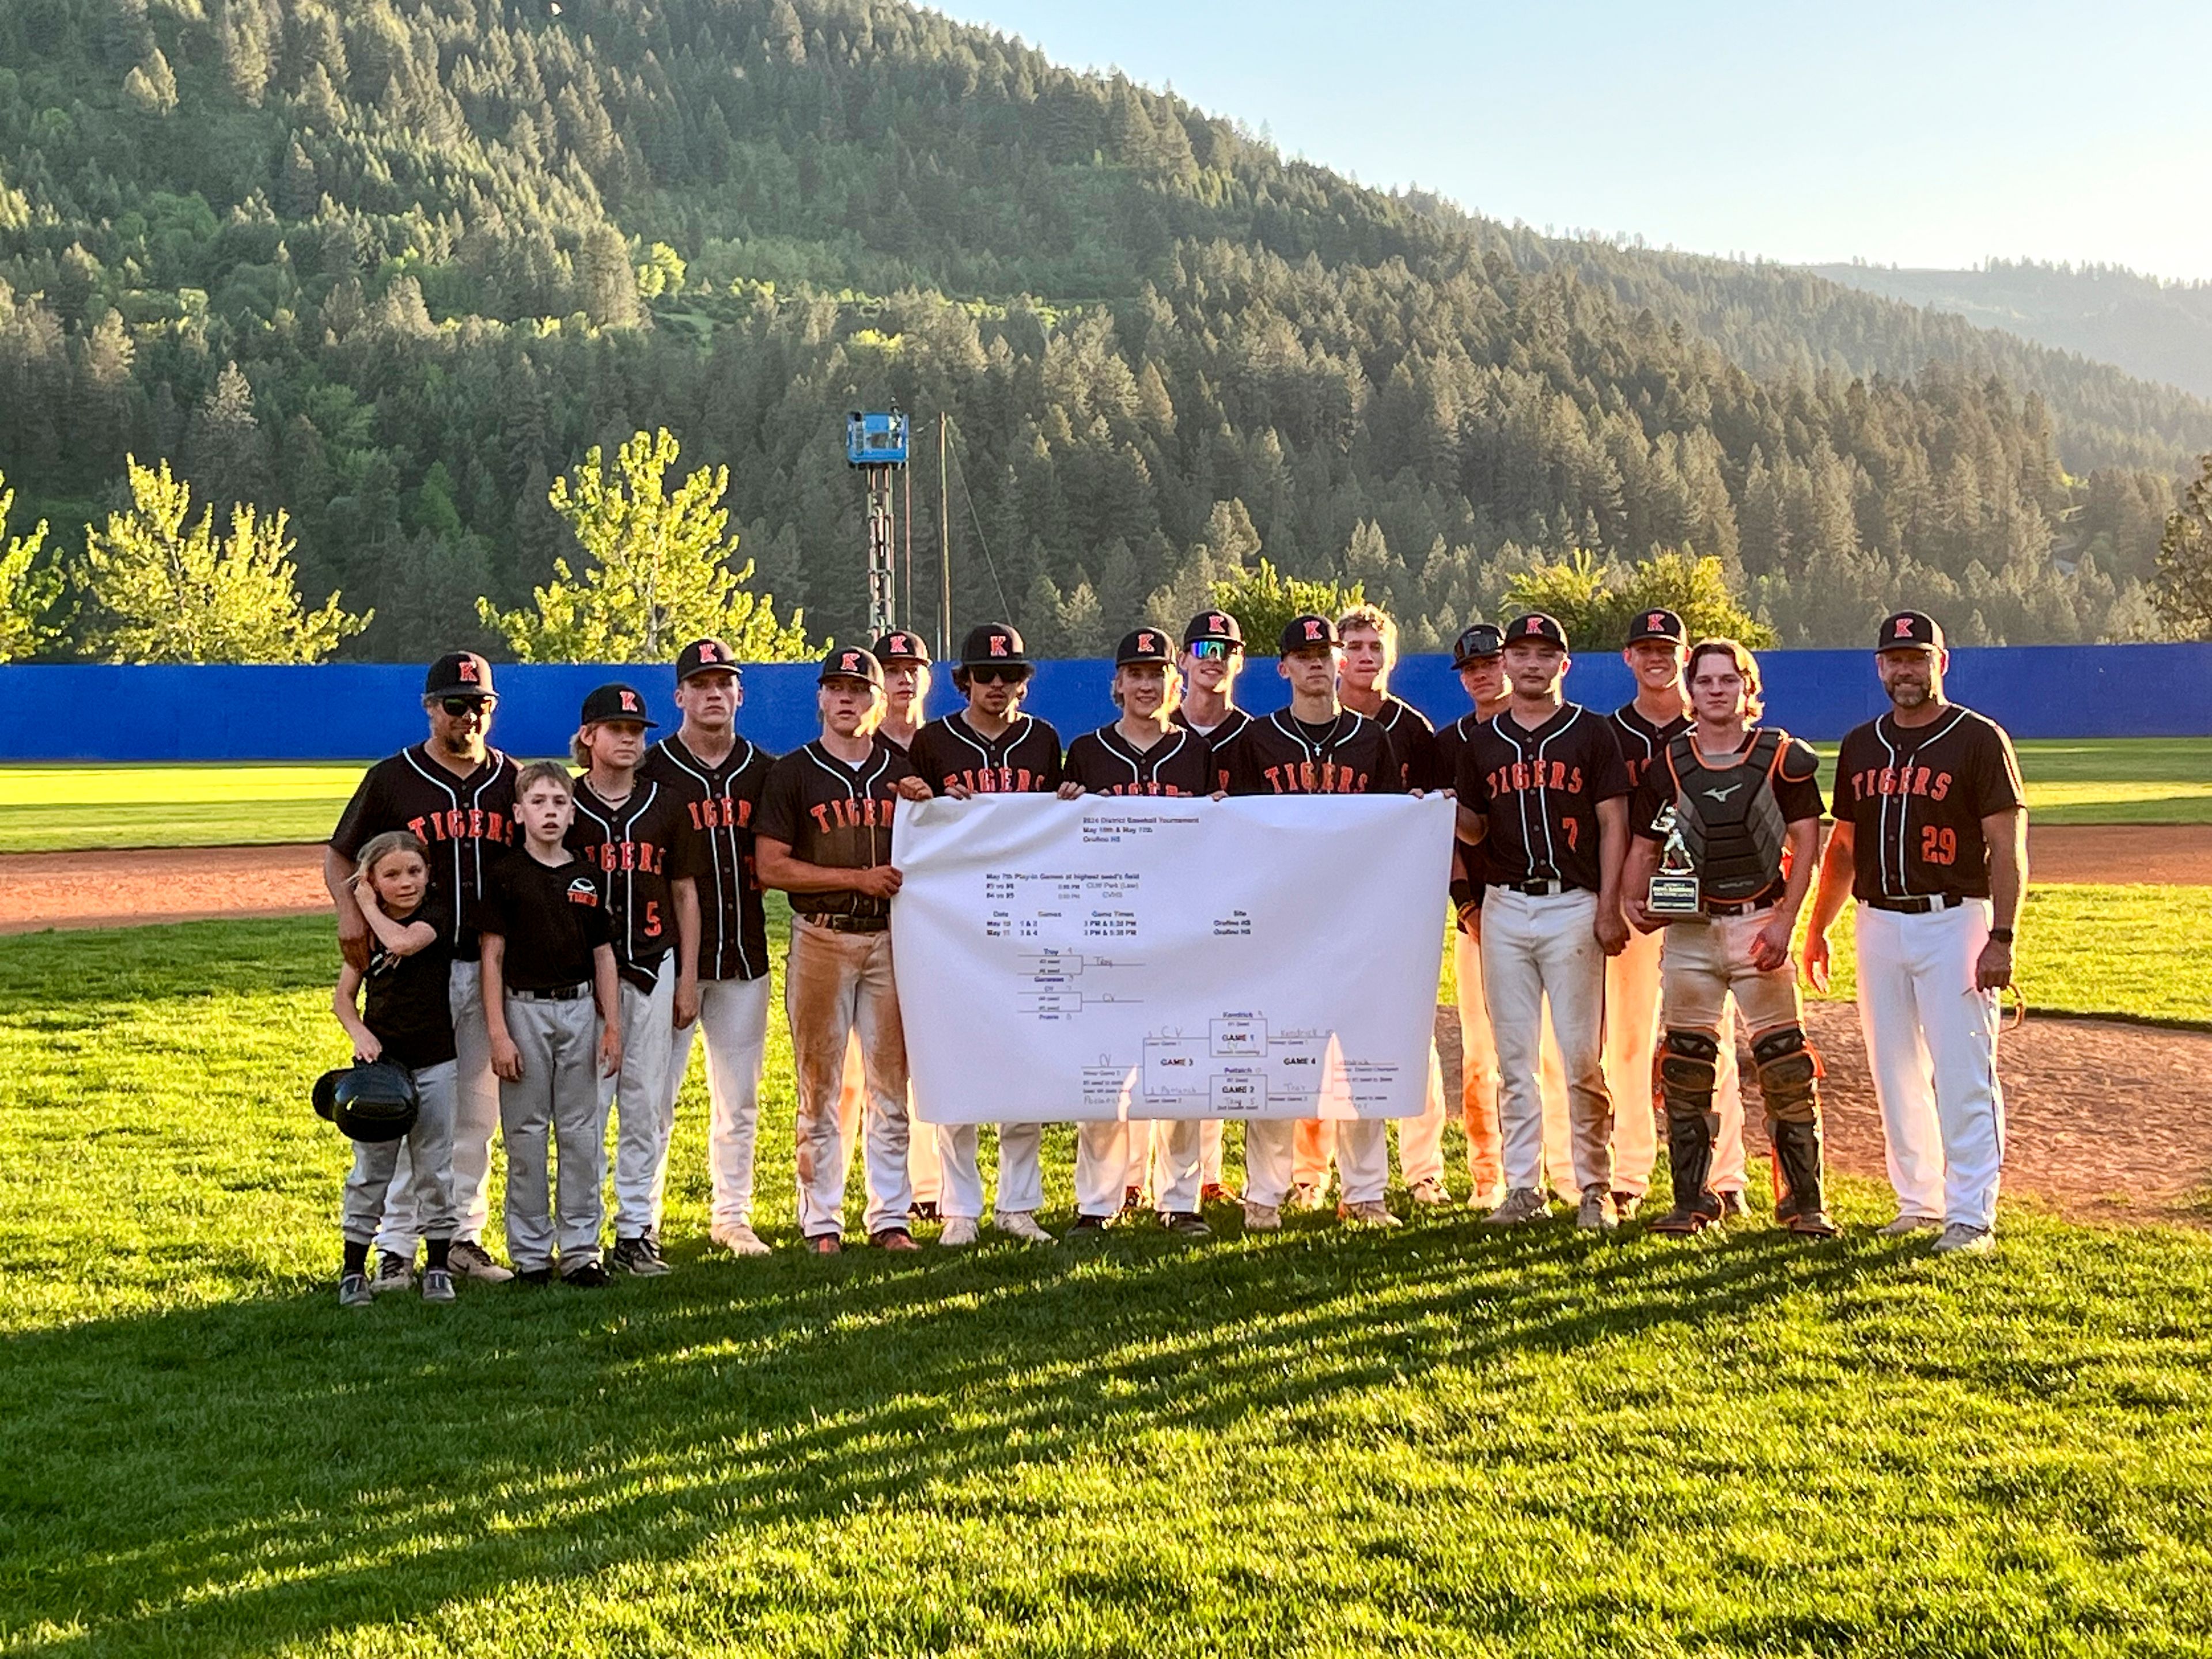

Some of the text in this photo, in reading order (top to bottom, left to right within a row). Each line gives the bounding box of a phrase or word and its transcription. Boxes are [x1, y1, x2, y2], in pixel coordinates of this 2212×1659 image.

[1208, 615, 1225, 632] K
[1304, 620, 1323, 640] K
[1525, 617, 1544, 634] K
[1647, 613, 1664, 631] K
[1895, 618, 1914, 638] K
[699, 643, 717, 662] K
[890, 635, 907, 653] K
[990, 635, 1007, 656] K
[1138, 634, 1155, 652] K
[459, 660, 478, 681] K
[841, 653, 859, 670] K
[619, 691, 638, 710] K
[1851, 766, 1952, 801] TIGERS
[810, 798, 894, 834] TIGER
[1562, 817, 1578, 853] 7
[1922, 825, 1956, 866] 29
[644, 900, 662, 937] 5
[1160, 1058, 1186, 1066] GAME
[1283, 1058, 1309, 1066] GAME
